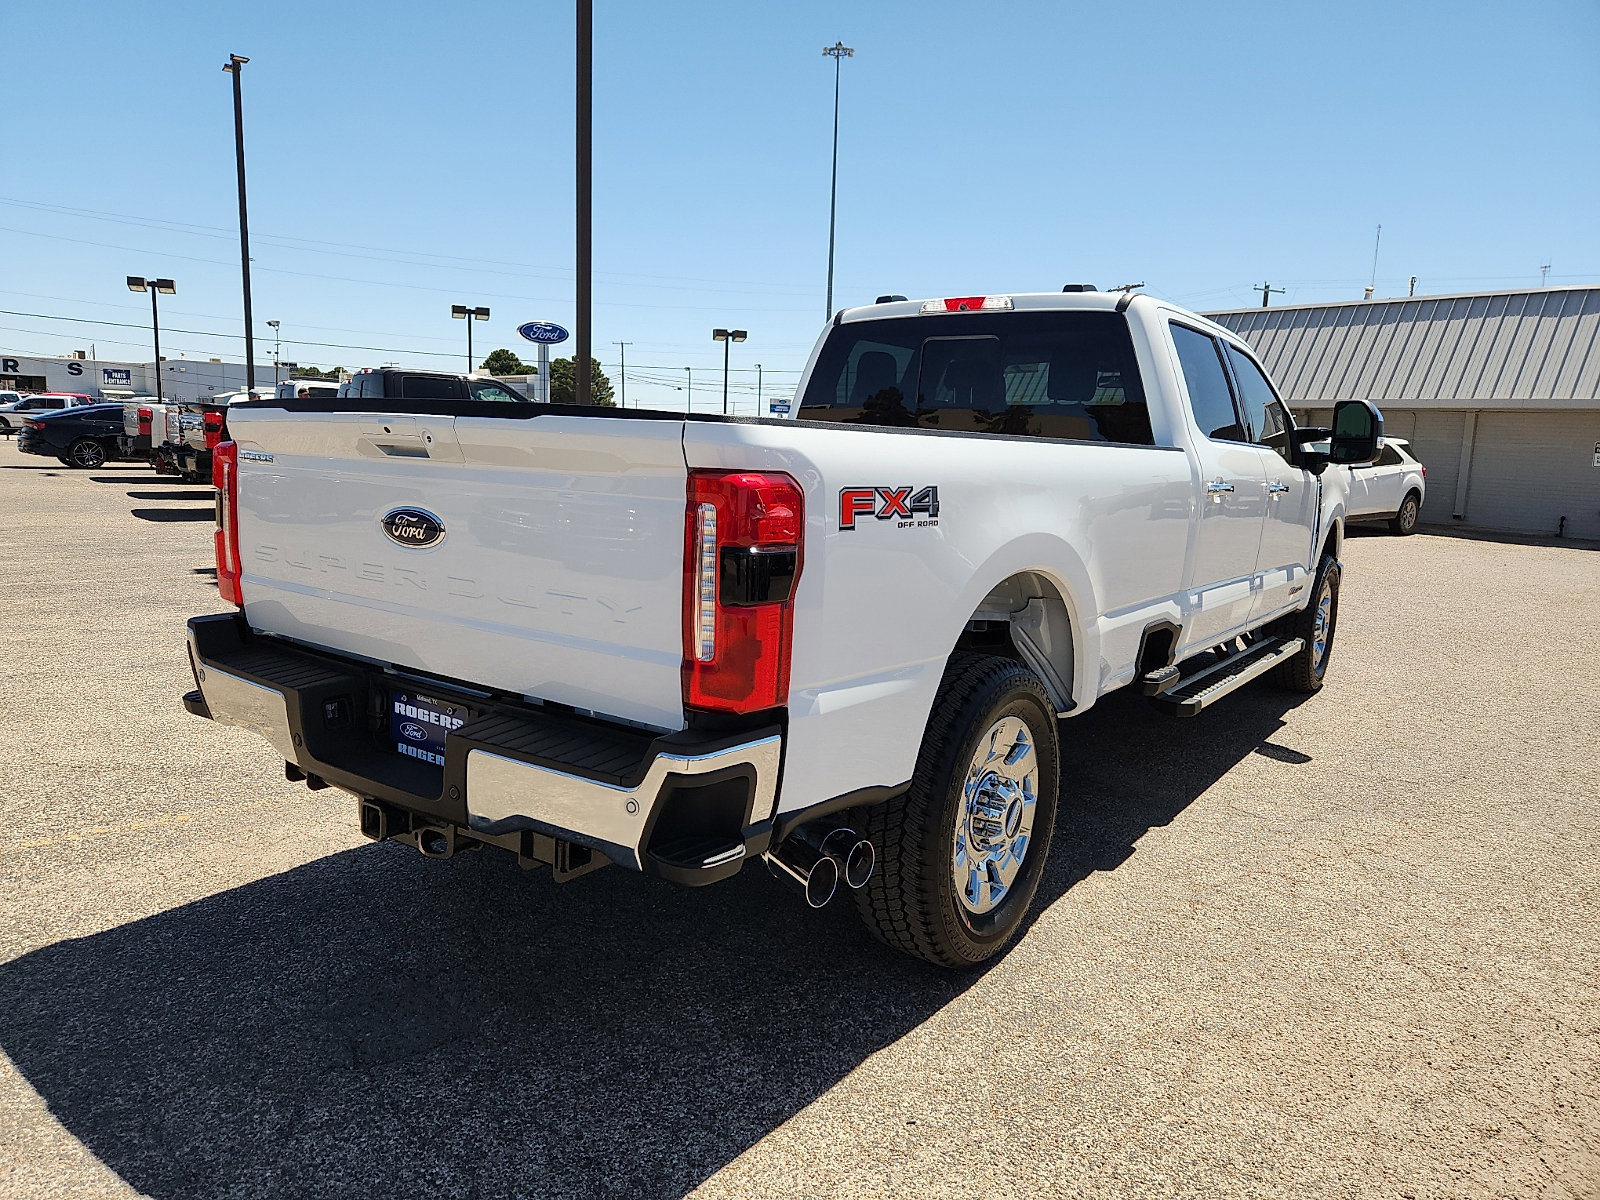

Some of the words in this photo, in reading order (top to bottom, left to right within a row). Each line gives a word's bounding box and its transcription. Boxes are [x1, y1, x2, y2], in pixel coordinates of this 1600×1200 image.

[530, 325, 560, 340] Ford
[838, 486, 940, 531] FX4
[392, 514, 426, 540] Ford
[897, 521, 915, 529] OFF
[917, 519, 939, 527] ROAD
[256, 545, 428, 591] SUPER
[448, 576, 643, 624] DUTY
[394, 701, 464, 730] ROGERS
[404, 724, 422, 739] Ford
[397, 742, 445, 767] ROGER
